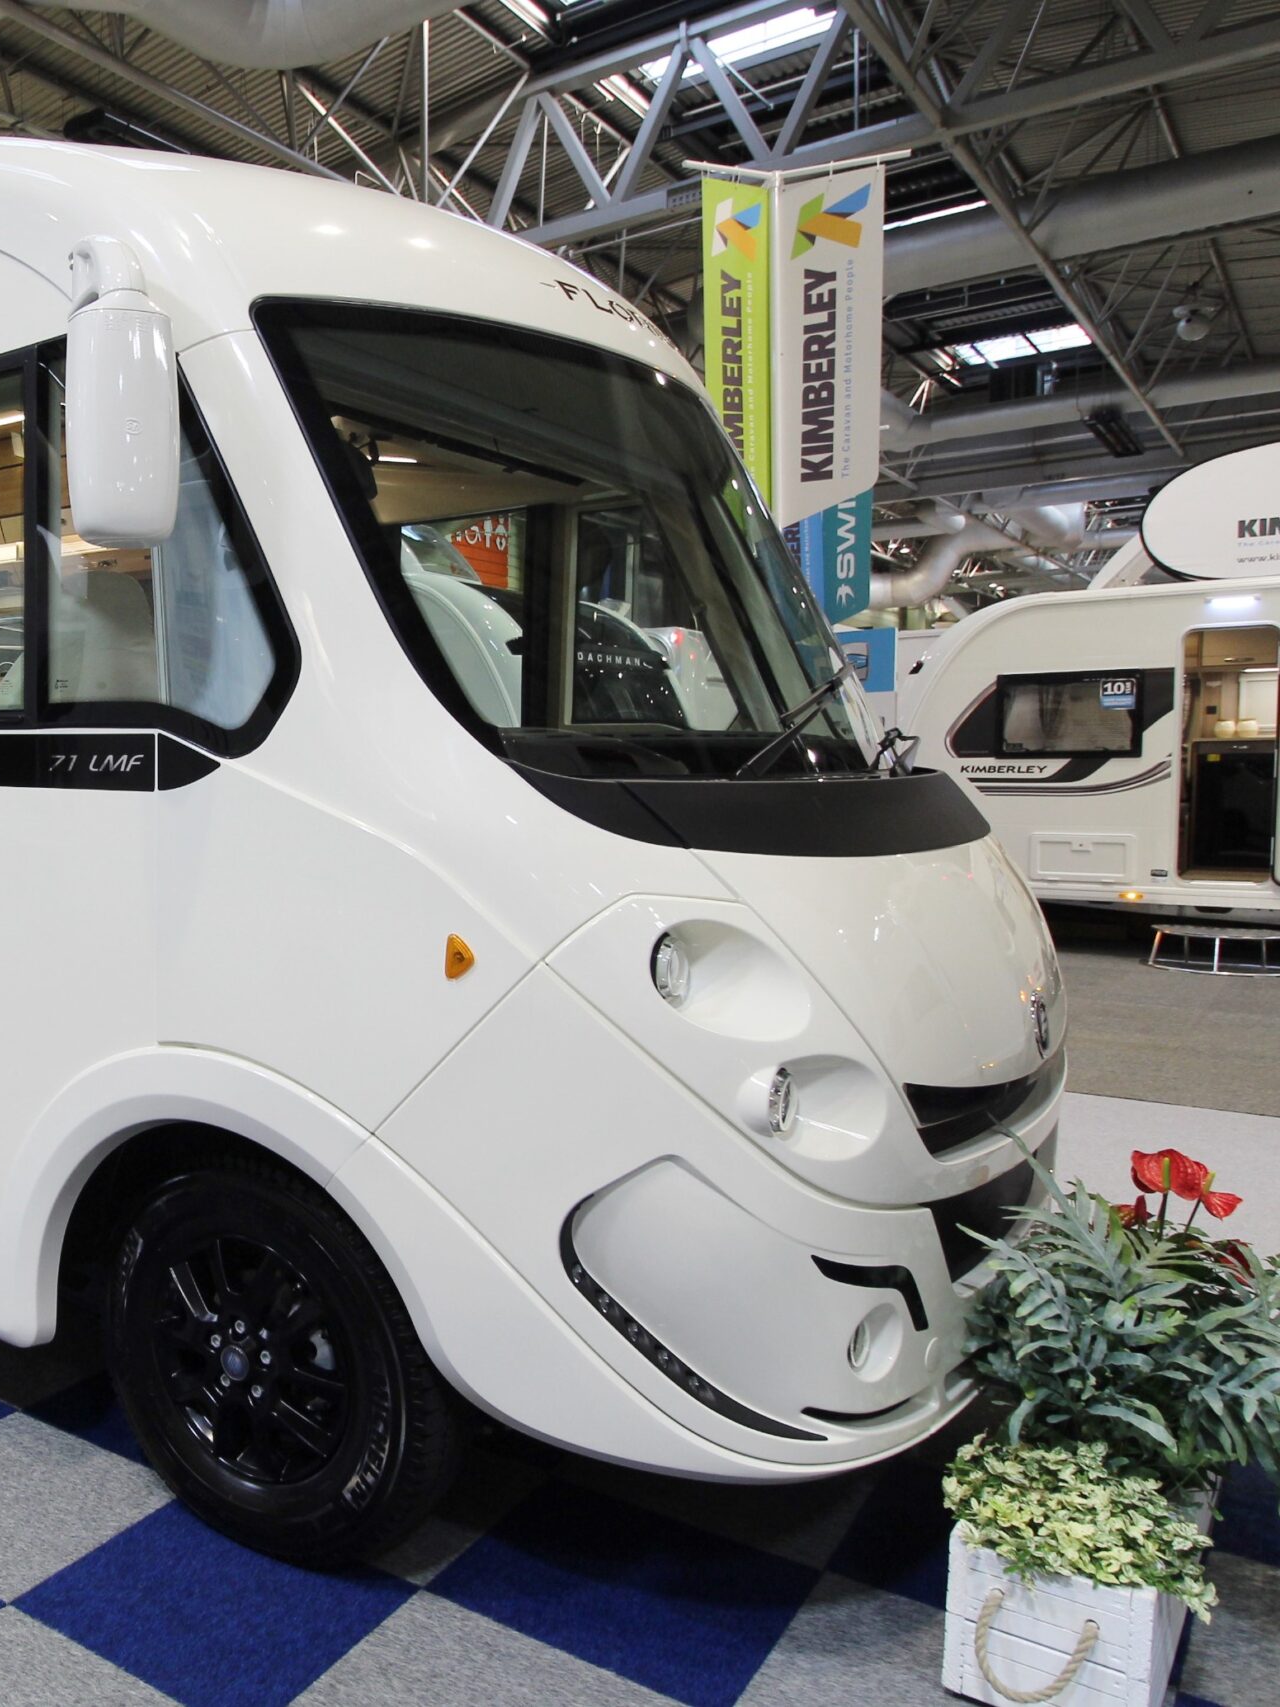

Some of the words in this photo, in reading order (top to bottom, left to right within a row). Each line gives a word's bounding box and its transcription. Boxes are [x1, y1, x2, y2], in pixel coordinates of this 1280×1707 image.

[845, 259, 855, 301] People
[844, 306, 854, 373] Motorhome
[720, 269, 745, 460] MBERLEY
[800, 268, 837, 483] KIMBERLEY
[844, 378, 852, 399] and
[842, 404, 852, 452] Caravan
[841, 457, 851, 478] The
[836, 501, 857, 580] SWI
[577, 651, 640, 667] OACHMAN
[1103, 681, 1125, 695] 10
[49, 754, 78, 771] 71
[88, 754, 144, 772] LMF
[960, 765, 1048, 774] KIMBERLEY
